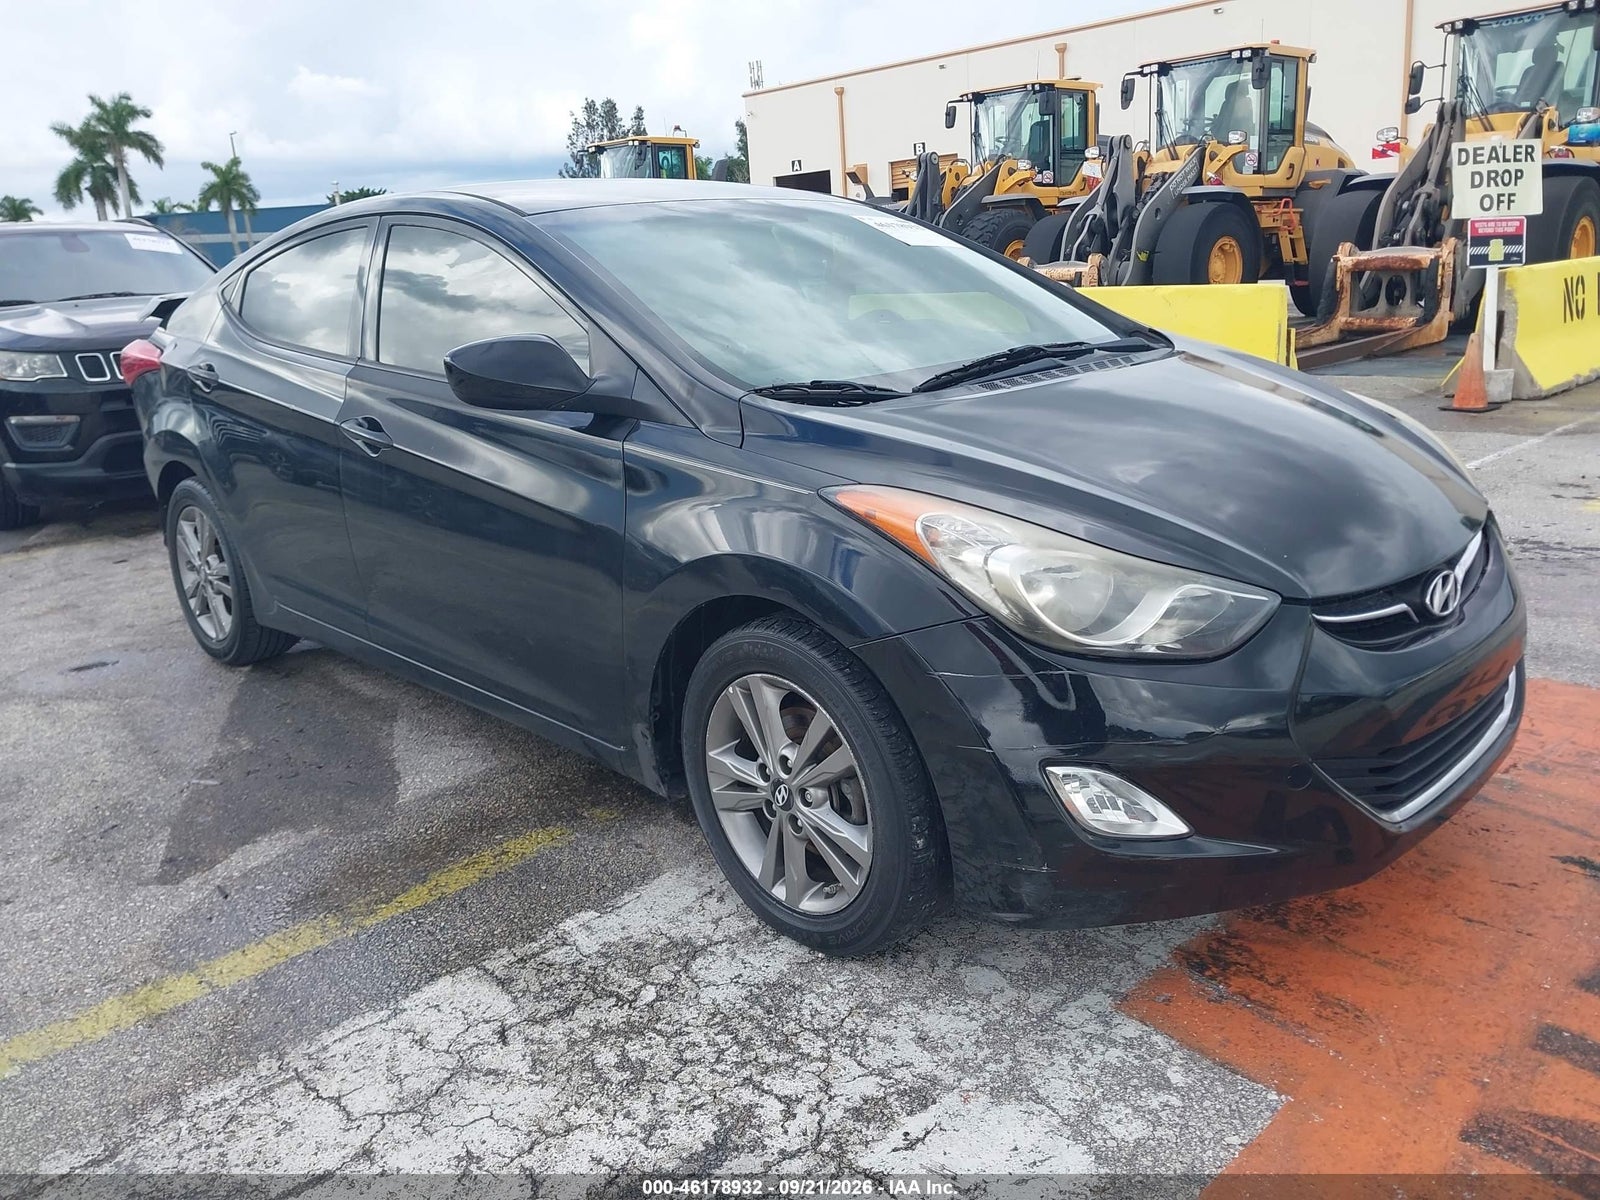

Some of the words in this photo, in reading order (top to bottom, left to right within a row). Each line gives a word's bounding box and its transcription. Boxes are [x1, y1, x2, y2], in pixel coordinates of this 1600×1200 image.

[1457, 144, 1536, 166] DEALER
[1470, 168, 1524, 189] DROP
[1479, 192, 1517, 212] OFF
[1563, 274, 1586, 324] NO
